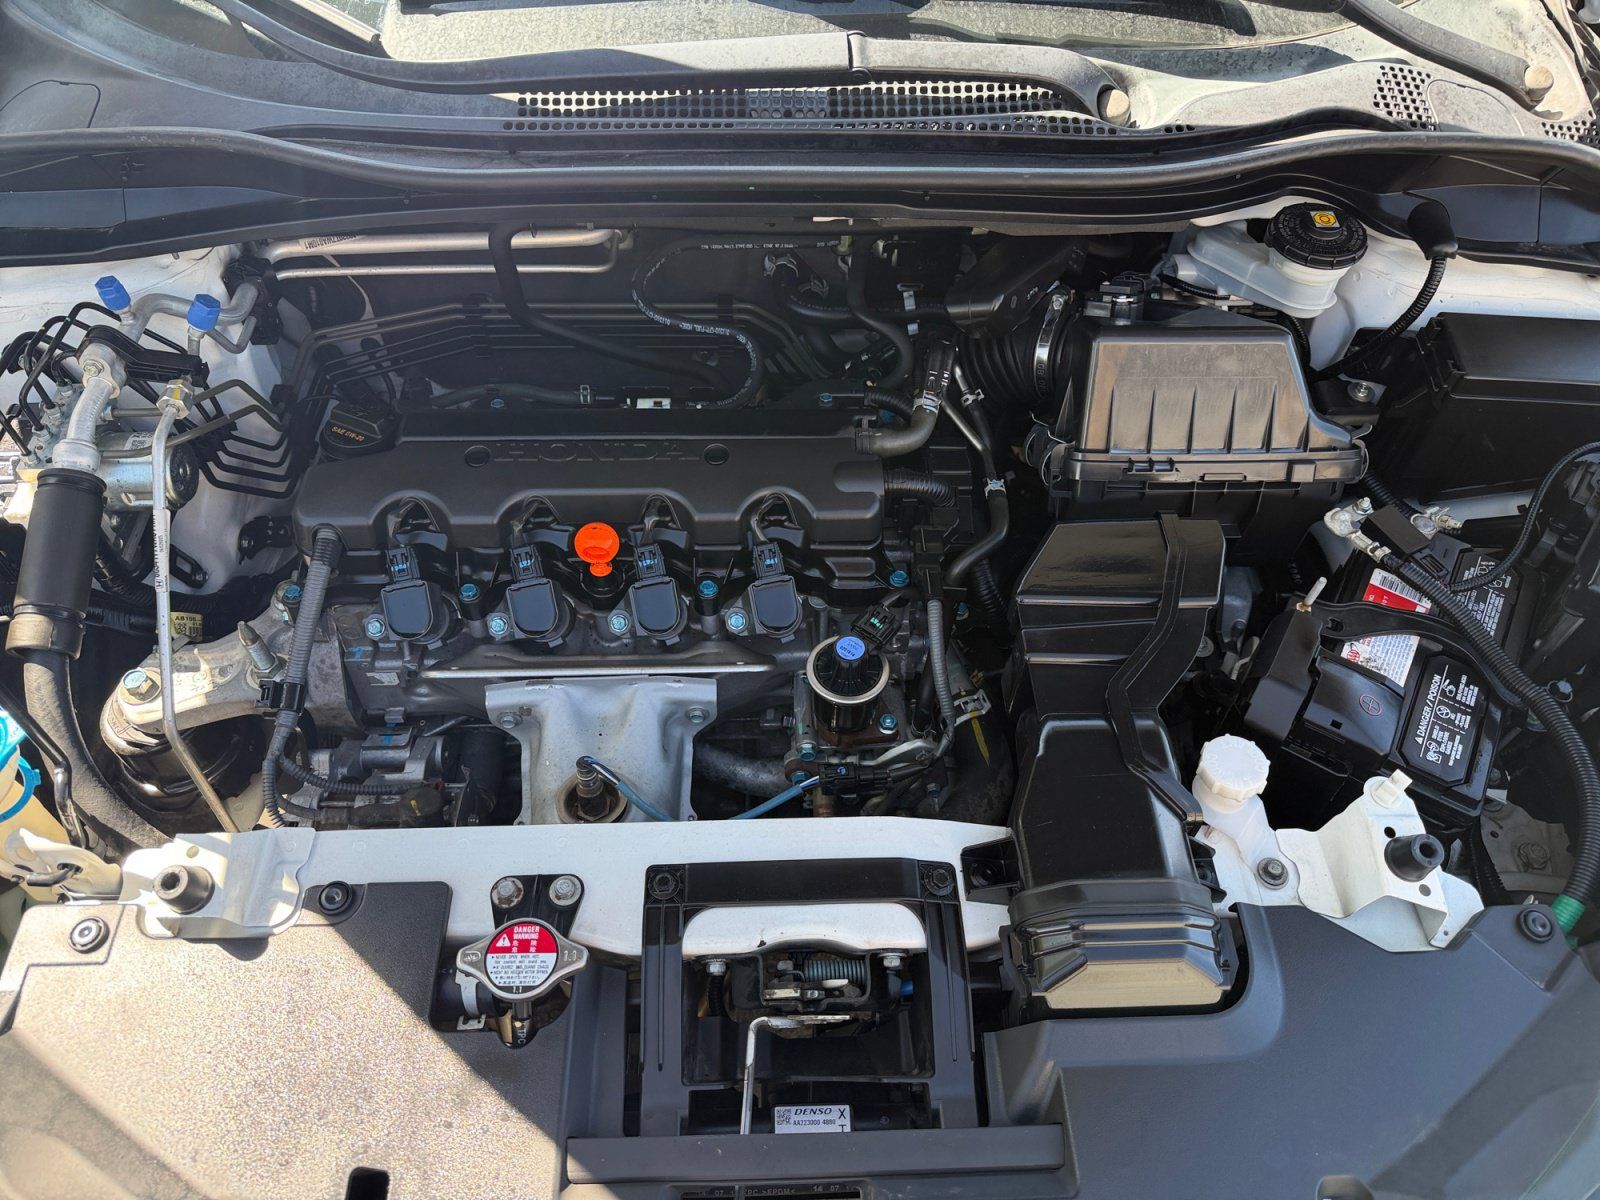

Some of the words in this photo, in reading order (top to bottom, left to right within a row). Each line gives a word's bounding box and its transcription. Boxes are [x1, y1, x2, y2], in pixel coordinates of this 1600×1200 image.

[494, 444, 700, 461] HONDA
[1416, 705, 1433, 737] DANGER
[1427, 674, 1442, 701] POISON
[514, 925, 540, 933] DANGER
[794, 1107, 832, 1116] DENSO
[838, 1108, 847, 1119] X
